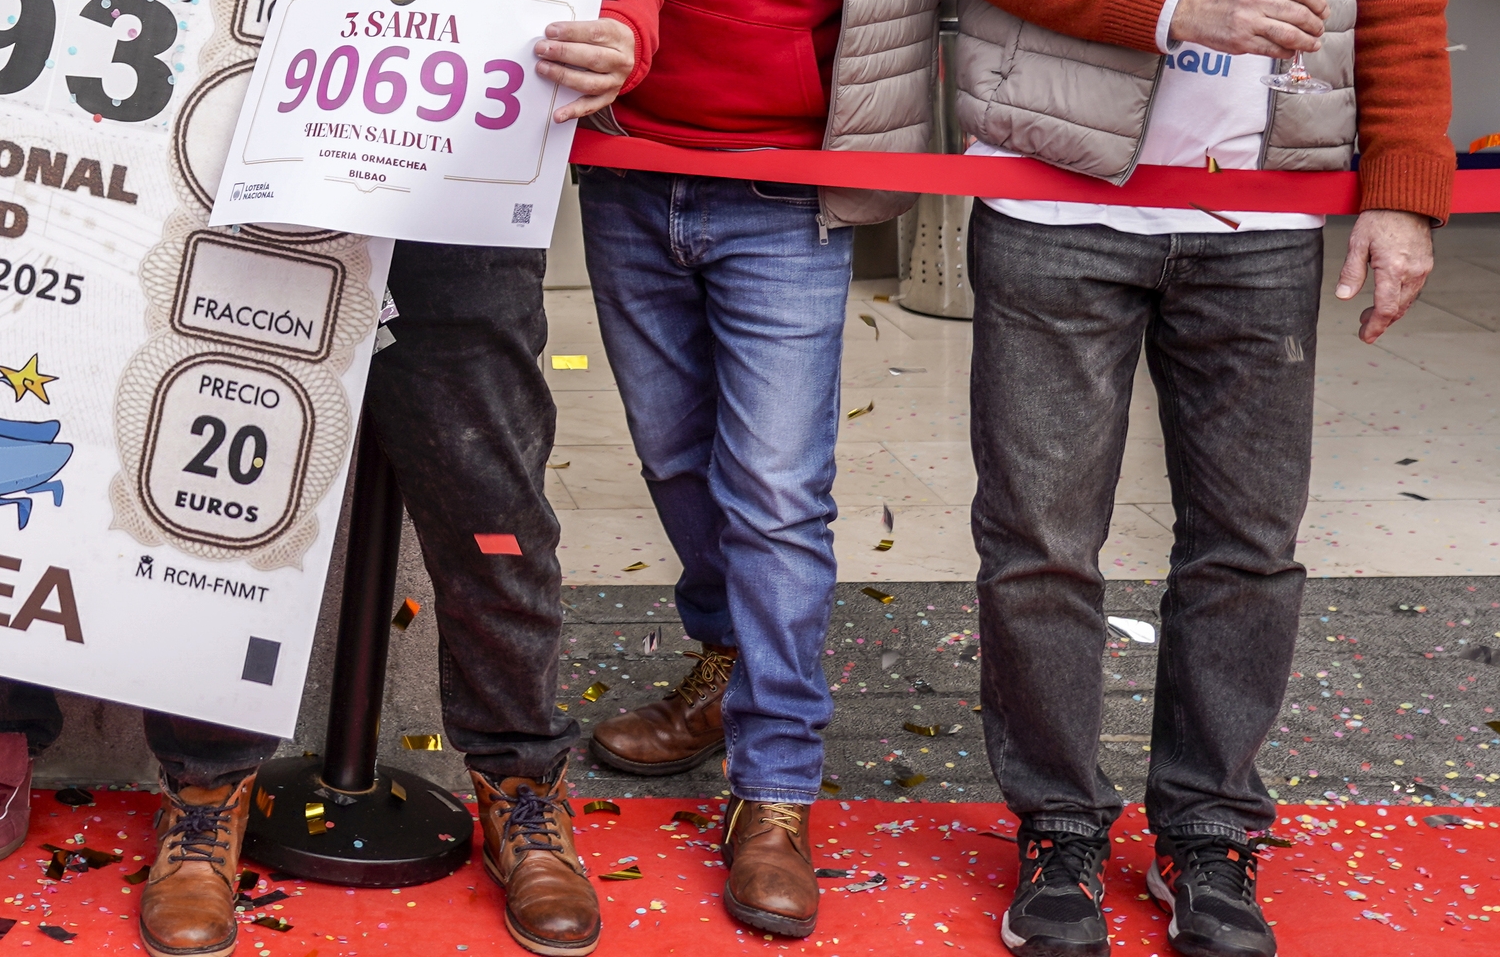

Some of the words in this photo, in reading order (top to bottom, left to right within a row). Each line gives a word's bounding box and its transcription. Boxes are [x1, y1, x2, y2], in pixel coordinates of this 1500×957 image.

[340, 11, 359, 39] 3.
[364, 10, 461, 43] SARIA
[277, 44, 525, 130] 90693
[304, 122, 363, 140] HEMEN
[364, 125, 454, 154] SALDUTA
[319, 149, 358, 161] LOTERIA
[361, 153, 427, 171] ORMAECHEA
[348, 169, 387, 183] BILBAO
[242, 190, 275, 200] NACIONAL
[244, 182, 270, 192] LOTERÍA
[193, 297, 313, 339] FRACCIÓN
[199, 375, 280, 409] PRECIO
[182, 414, 268, 485] 20
[175, 491, 258, 523] EUROS
[163, 567, 269, 603] RCM-FNMT
